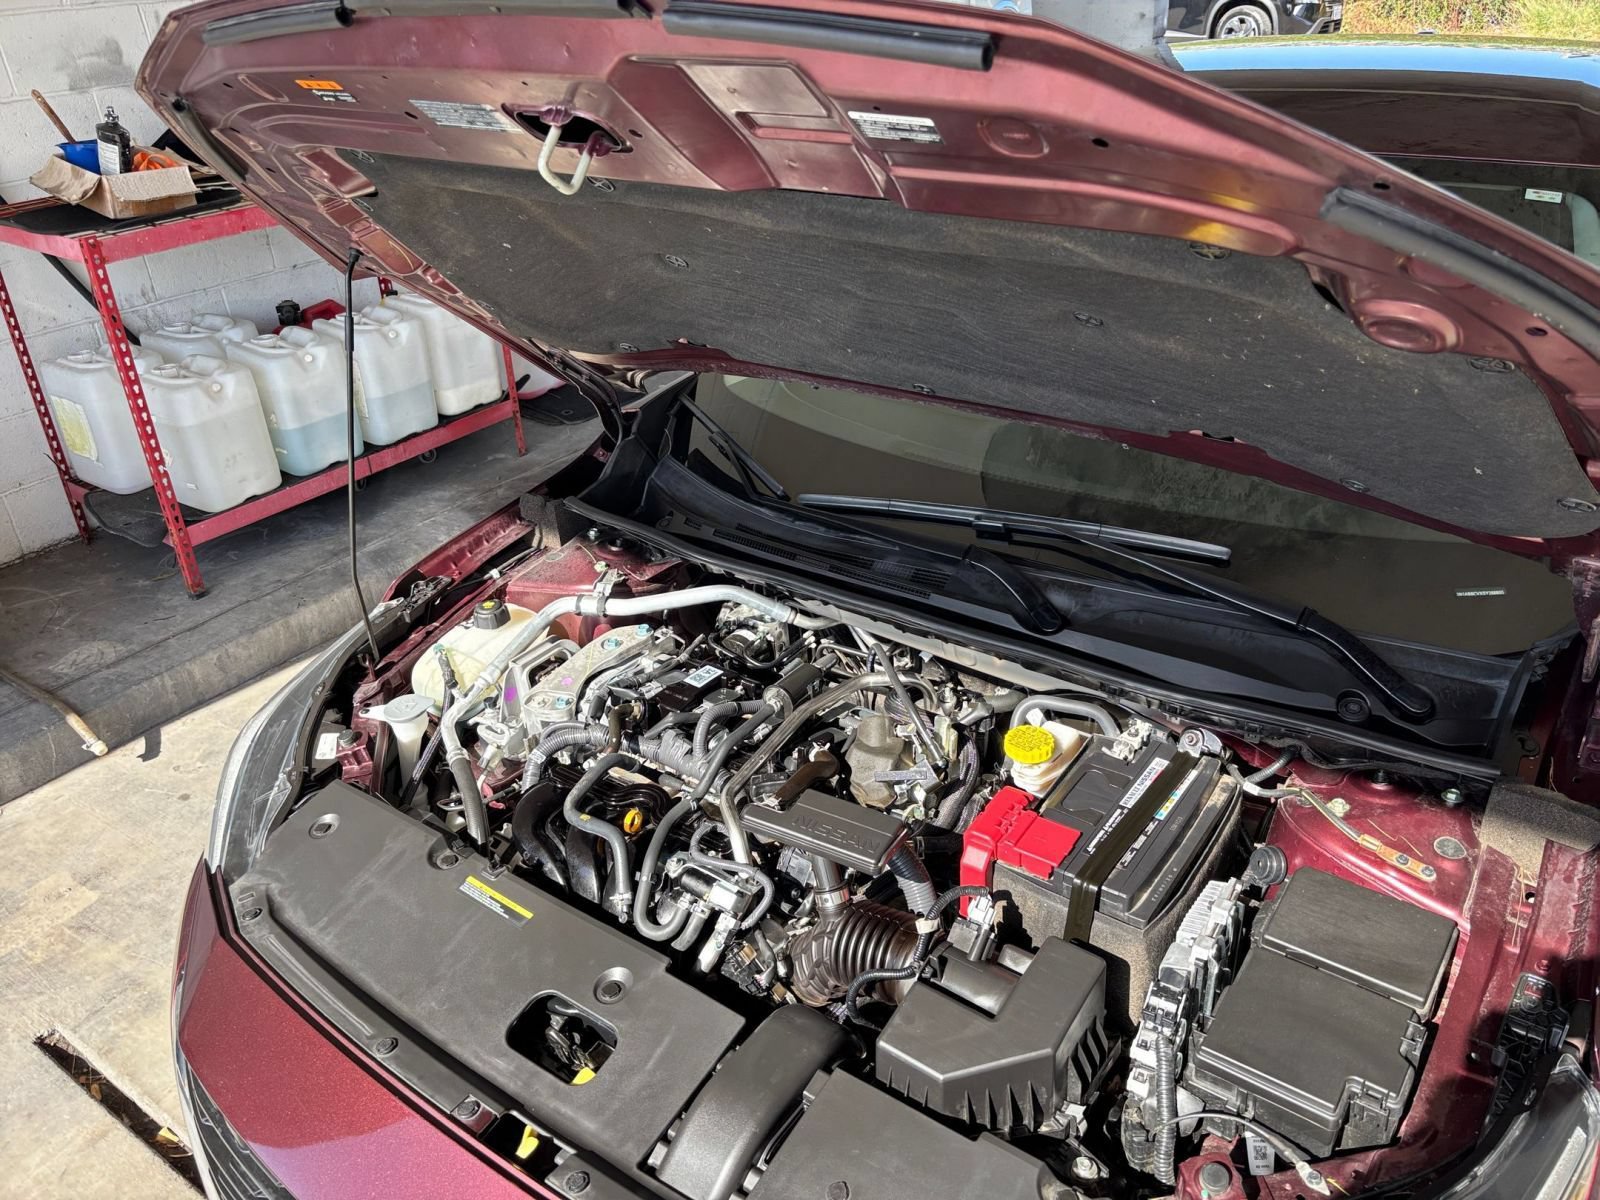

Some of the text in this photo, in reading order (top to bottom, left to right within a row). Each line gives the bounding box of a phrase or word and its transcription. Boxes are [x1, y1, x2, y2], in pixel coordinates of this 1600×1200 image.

[1122, 785, 1140, 806] RENAULT
[1139, 766, 1157, 787] NISSAN
[792, 815, 880, 853] NISSAN
